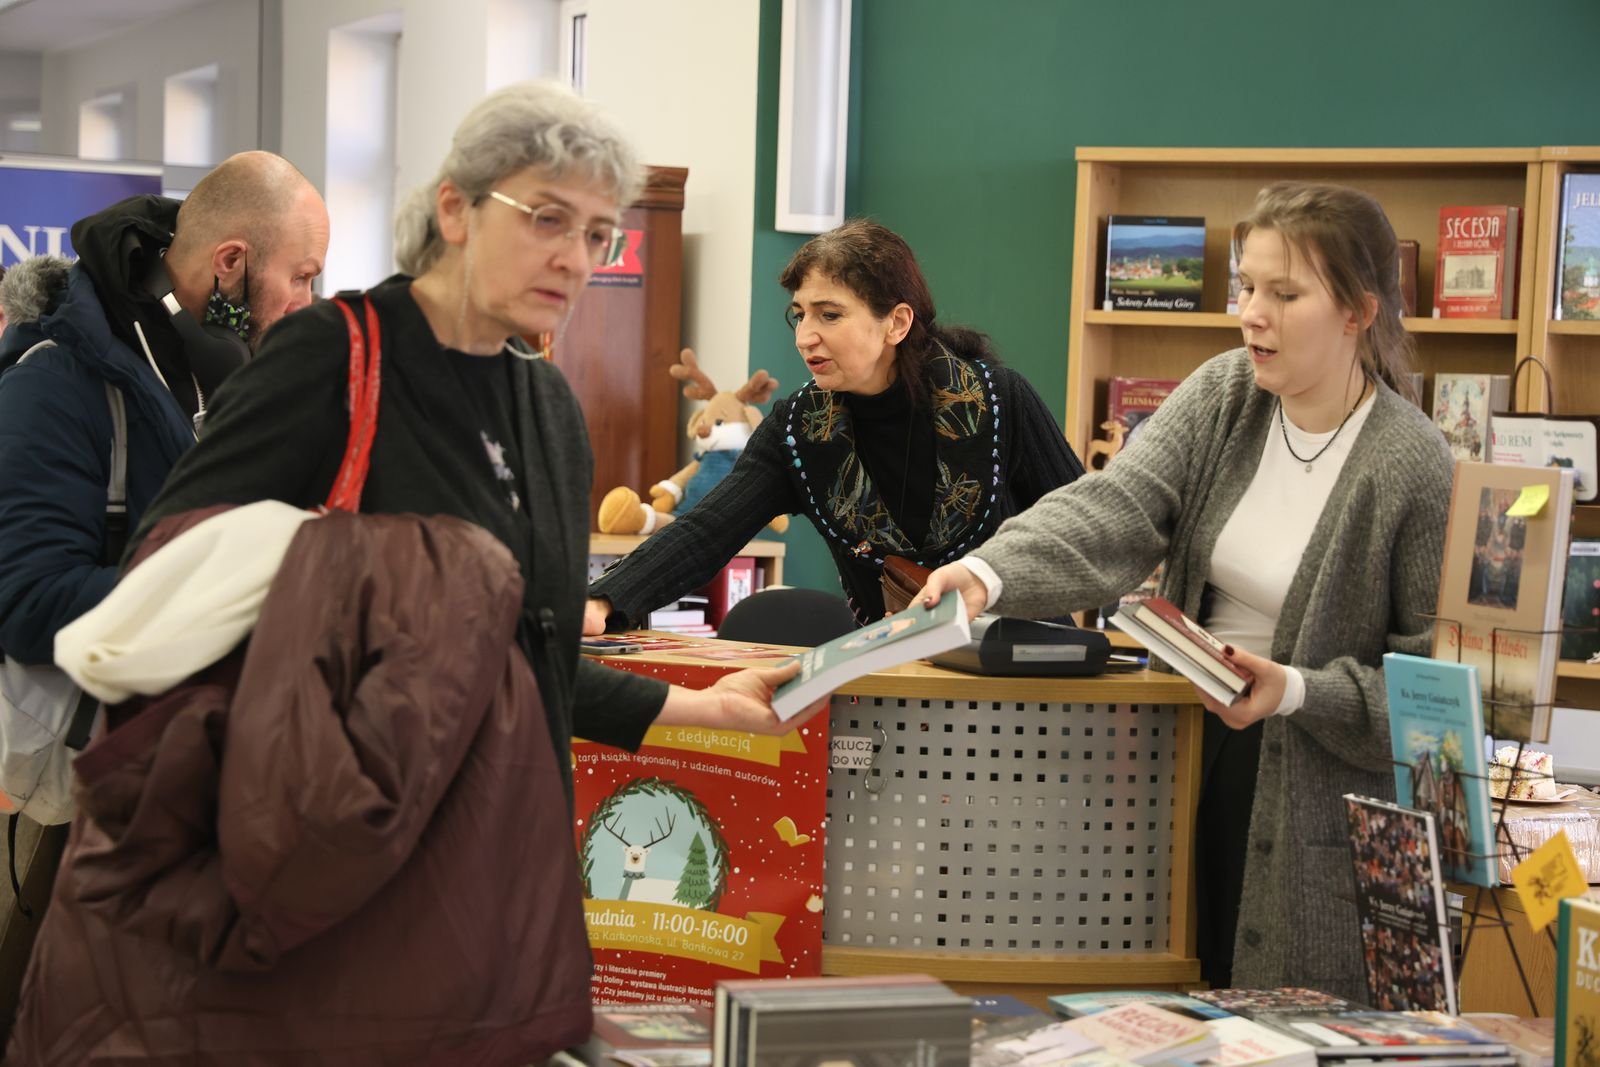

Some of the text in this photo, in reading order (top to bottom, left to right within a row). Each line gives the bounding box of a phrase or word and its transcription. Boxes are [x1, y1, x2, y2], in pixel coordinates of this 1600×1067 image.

[1572, 191, 1600, 209] JEL
[1446, 216, 1500, 239] SECESJA
[1116, 297, 1142, 308] Sekrety
[1144, 297, 1173, 310] Jeleniej
[665, 729, 751, 752] z dedykacją
[833, 740, 872, 751] KLUCZ
[578, 753, 599, 764] targi
[601, 752, 630, 763] książki
[633, 754, 680, 770] regionalnej
[690, 762, 732, 776] udziałem
[735, 771, 777, 786] autorów
[833, 755, 849, 765] DO
[584, 908, 748, 945] rudnia 11:00-16:00
[682, 939, 729, 959] Bankowa
[732, 950, 745, 961] 27
[1577, 926, 1600, 971] K
[603, 976, 624, 986] Doliny
[638, 970, 667, 981] premiery
